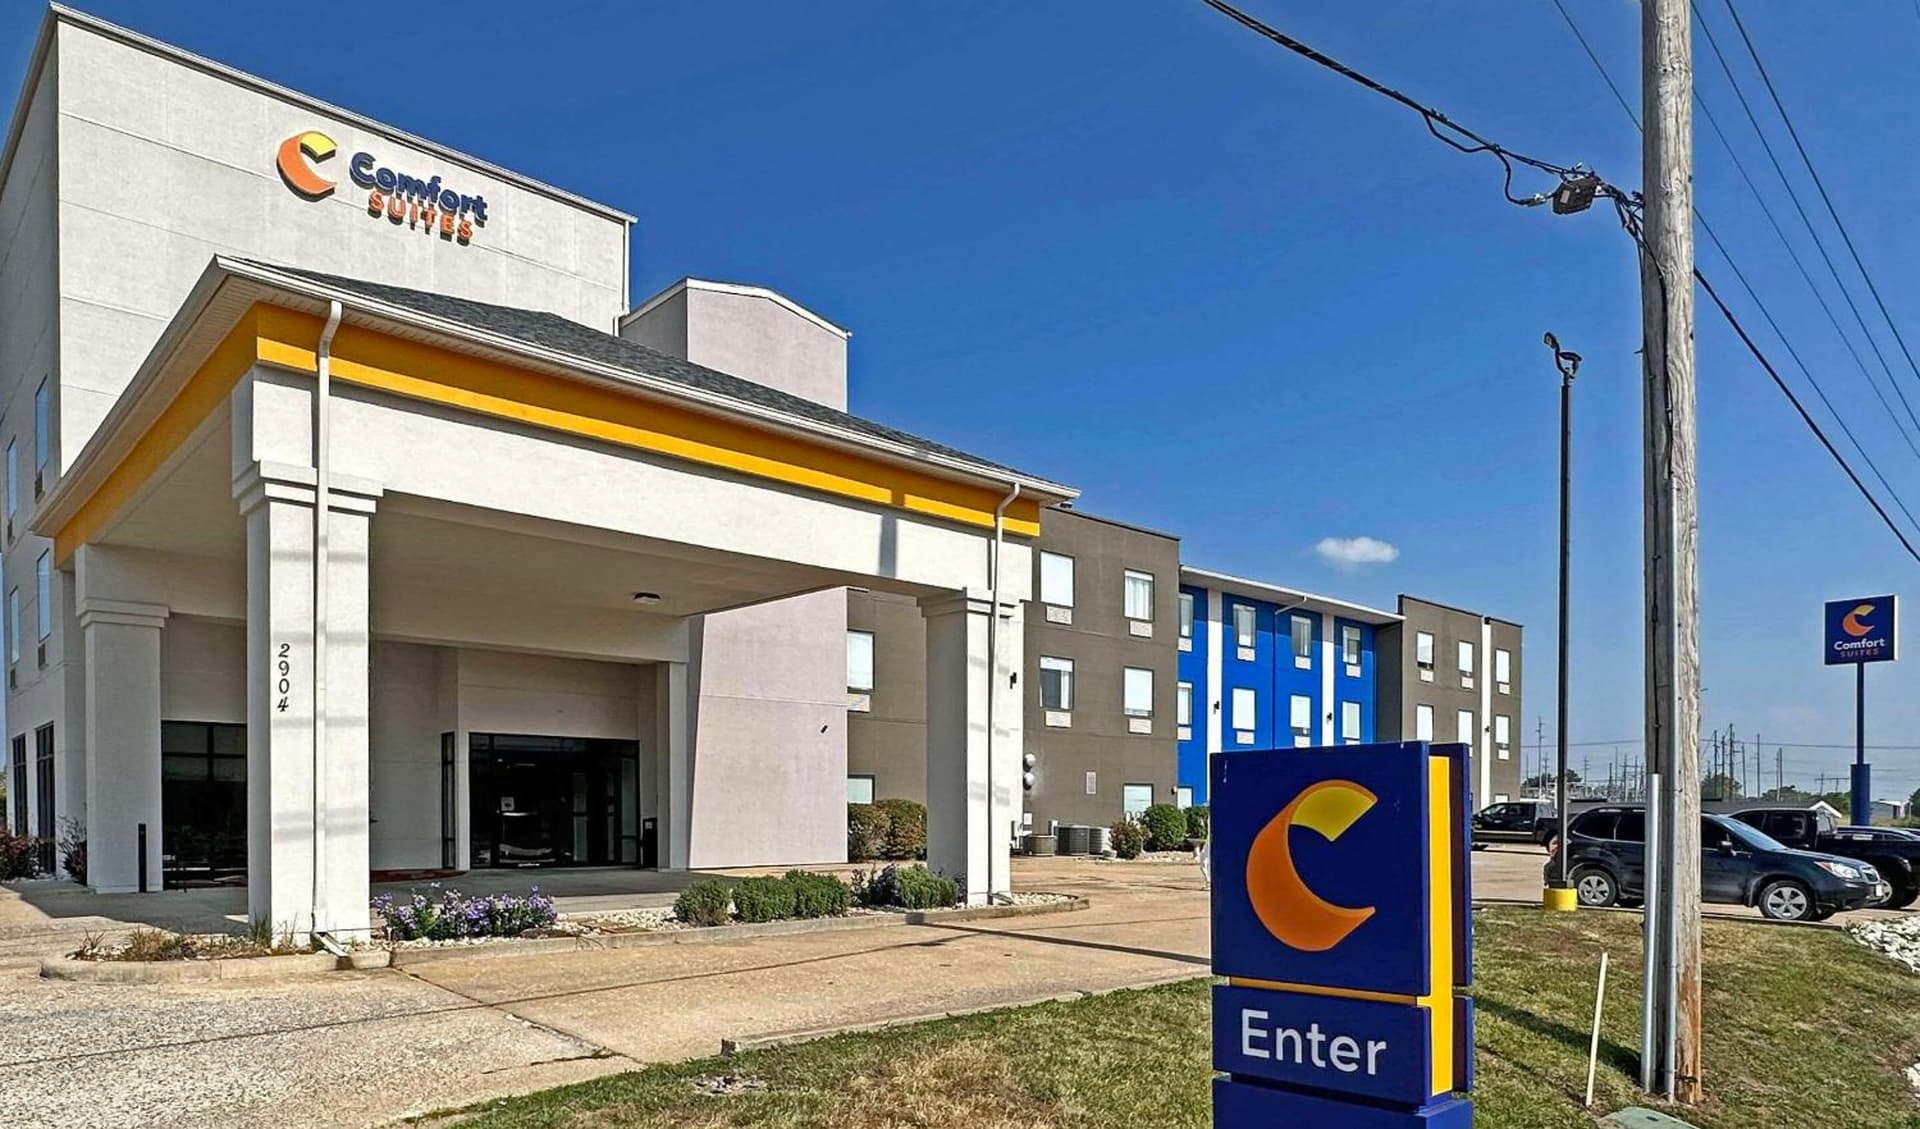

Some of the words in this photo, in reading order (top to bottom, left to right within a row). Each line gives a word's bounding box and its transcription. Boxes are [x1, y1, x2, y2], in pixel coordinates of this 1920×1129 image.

[350, 151, 488, 224] Comfort
[367, 190, 473, 242] SUITES
[1833, 638, 1885, 650] Comfort
[1840, 648, 1880, 658] SUITES
[277, 643, 290, 713] 2904
[1241, 1008, 1387, 1076] Enter
